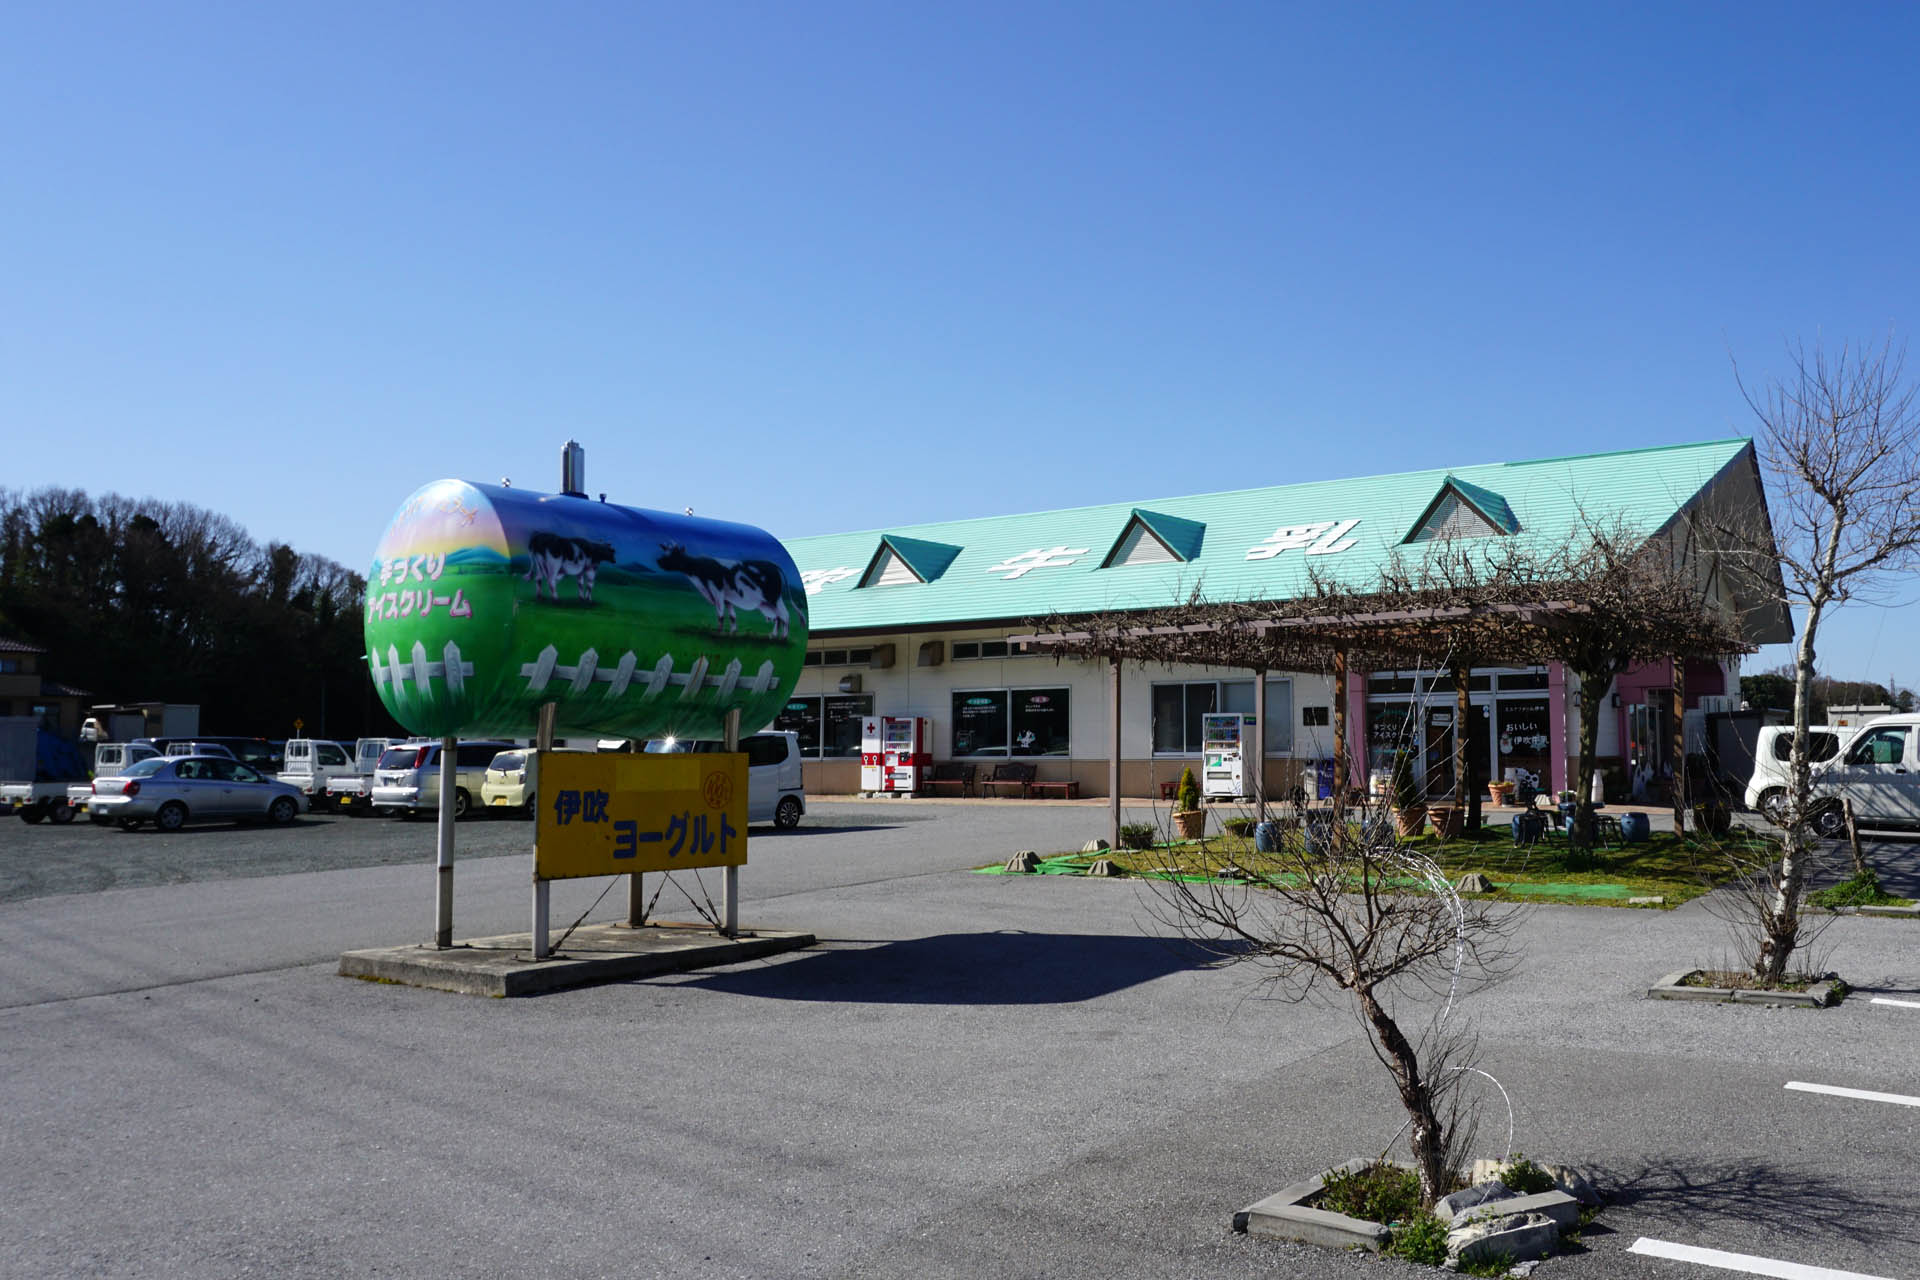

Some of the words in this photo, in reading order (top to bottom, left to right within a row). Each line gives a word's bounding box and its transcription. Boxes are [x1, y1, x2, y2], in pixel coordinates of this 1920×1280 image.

[380, 551, 446, 587] 手づくり
[367, 588, 473, 624] アイスクリーム
[1505, 722, 1538, 732] おいしい
[553, 789, 610, 825] 伊吹
[612, 810, 737, 860] ヨーグルト
